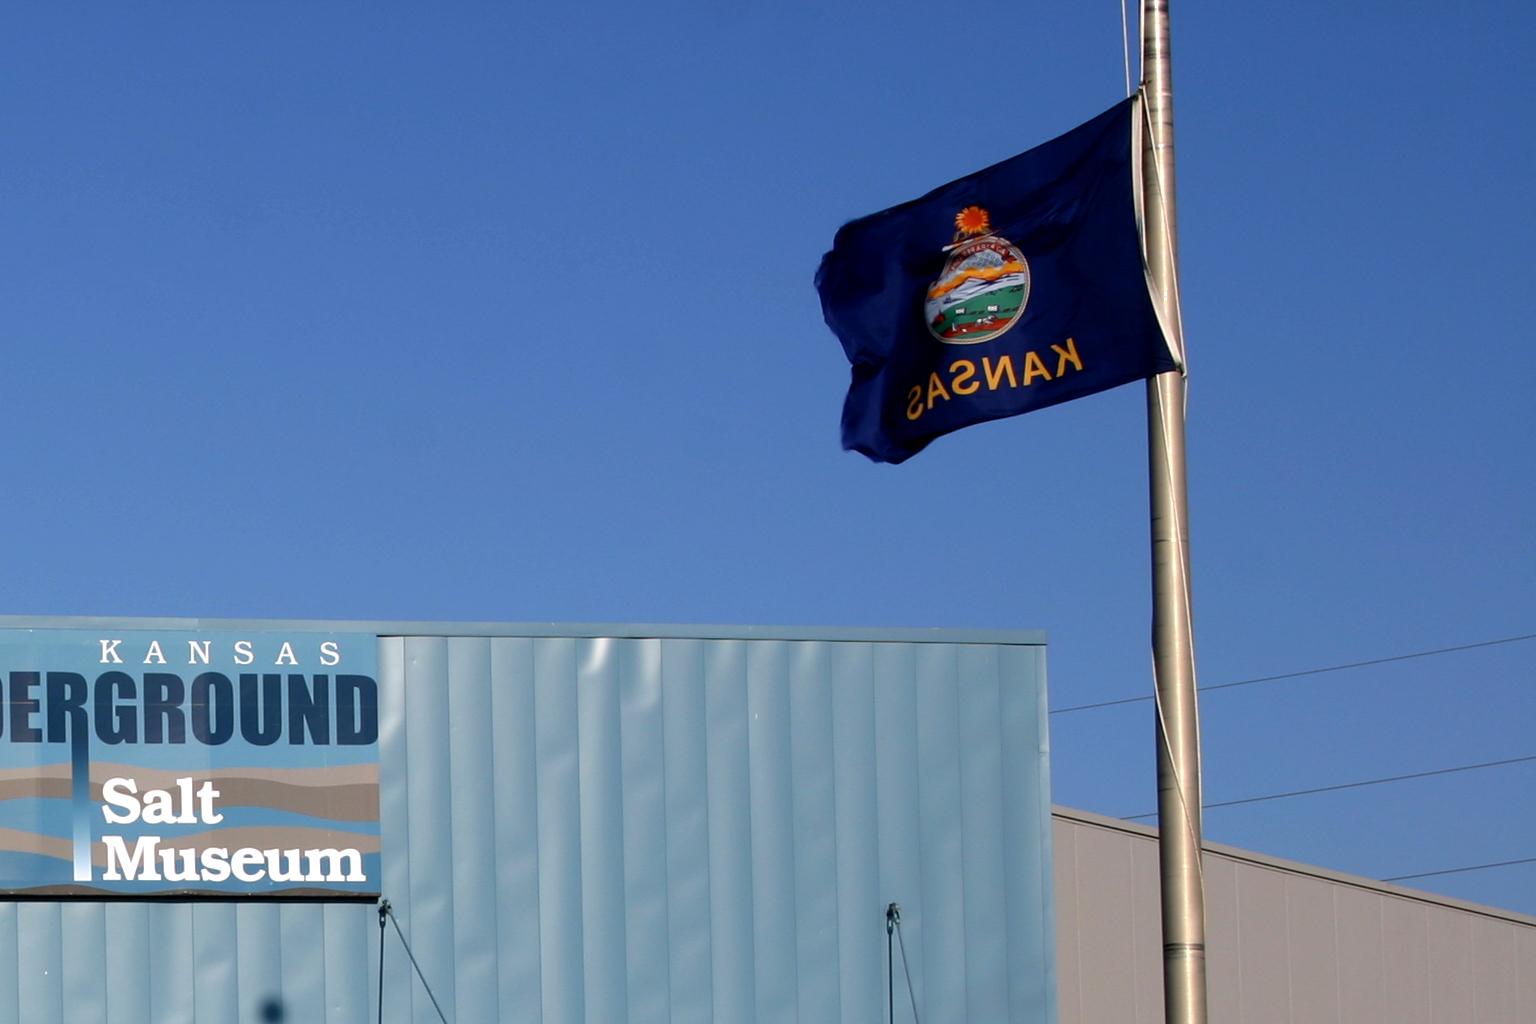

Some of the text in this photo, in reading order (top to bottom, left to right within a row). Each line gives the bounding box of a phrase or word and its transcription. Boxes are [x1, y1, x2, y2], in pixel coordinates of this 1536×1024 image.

[99, 640, 340, 666] KANSAS
[102, 777, 223, 825] Salt
[102, 835, 366, 882] Museum
